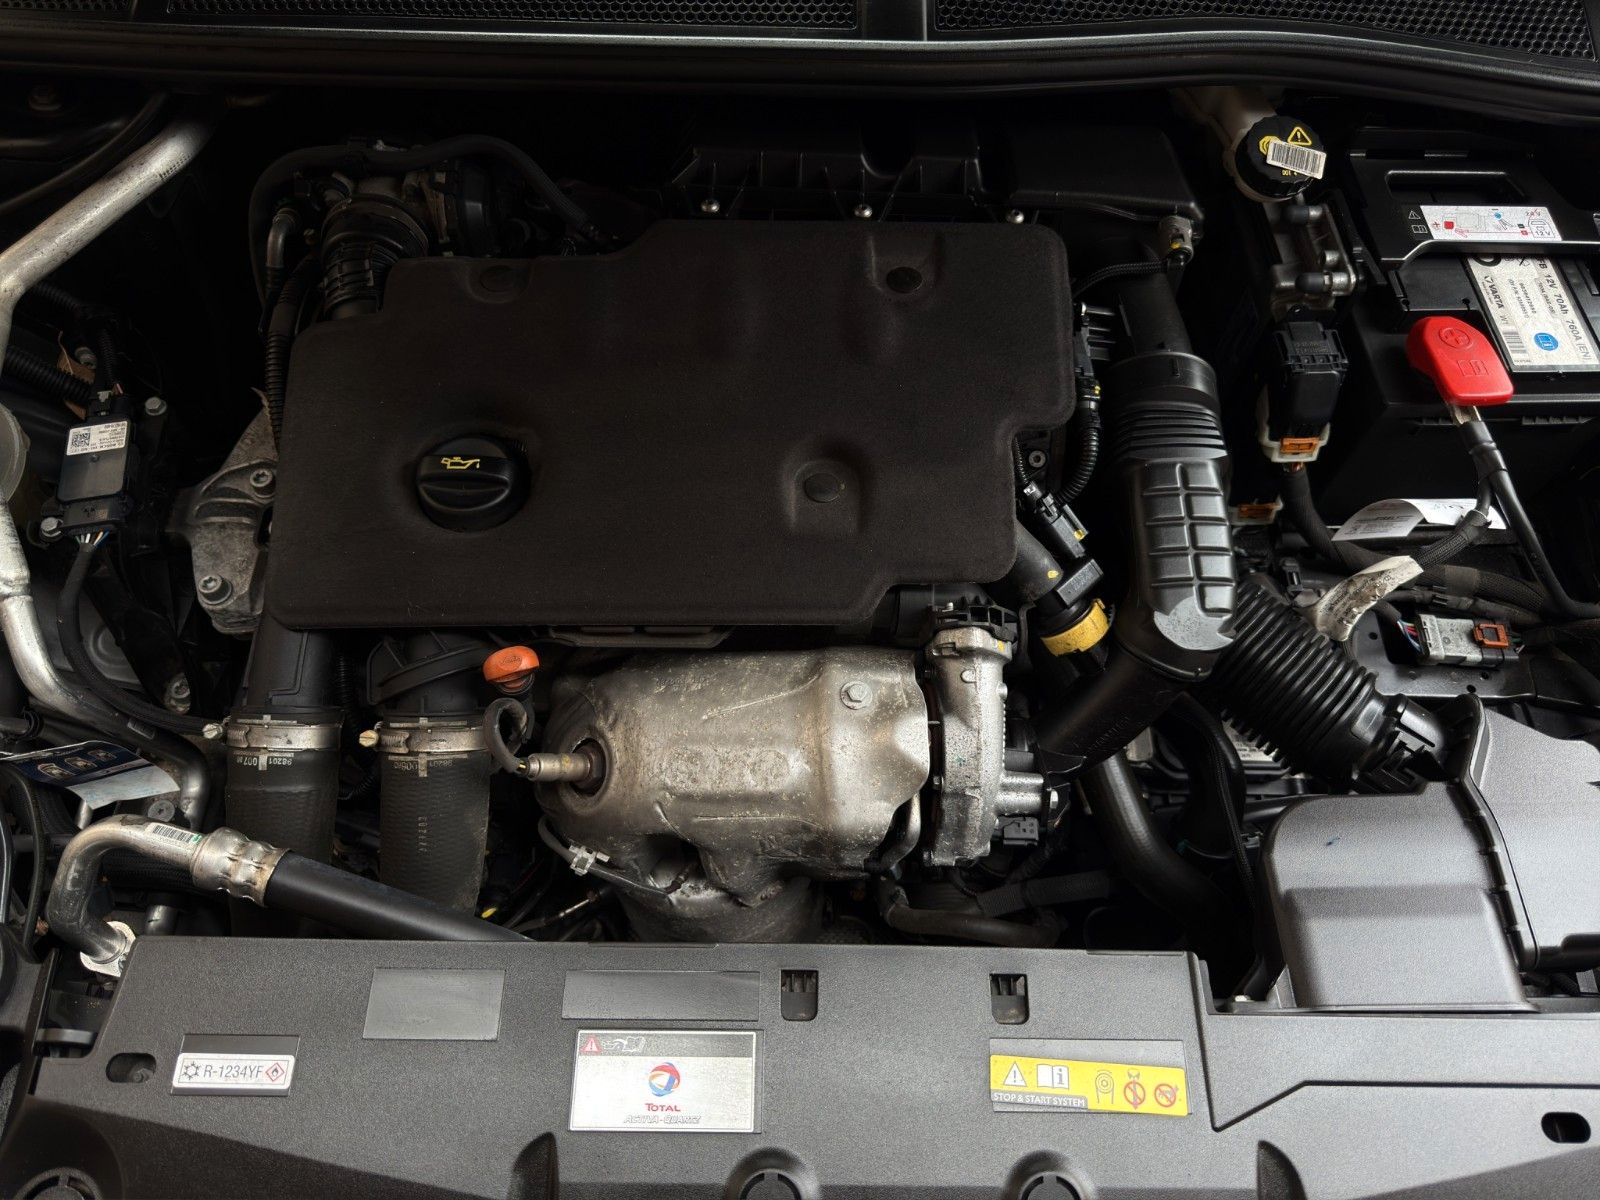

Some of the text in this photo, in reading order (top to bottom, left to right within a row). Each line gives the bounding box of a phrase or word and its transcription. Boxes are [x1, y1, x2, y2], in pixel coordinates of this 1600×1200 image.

[1488, 282, 1504, 308] VARTA
[1544, 274, 1558, 290] 12V
[1554, 294, 1569, 315] 70Ah
[1566, 320, 1583, 341] 760A
[203, 1064, 264, 1078] R-1234YF
[993, 1092, 1085, 1107] STOP & START SYSTEM
[645, 1103, 681, 1112] TOTAL
